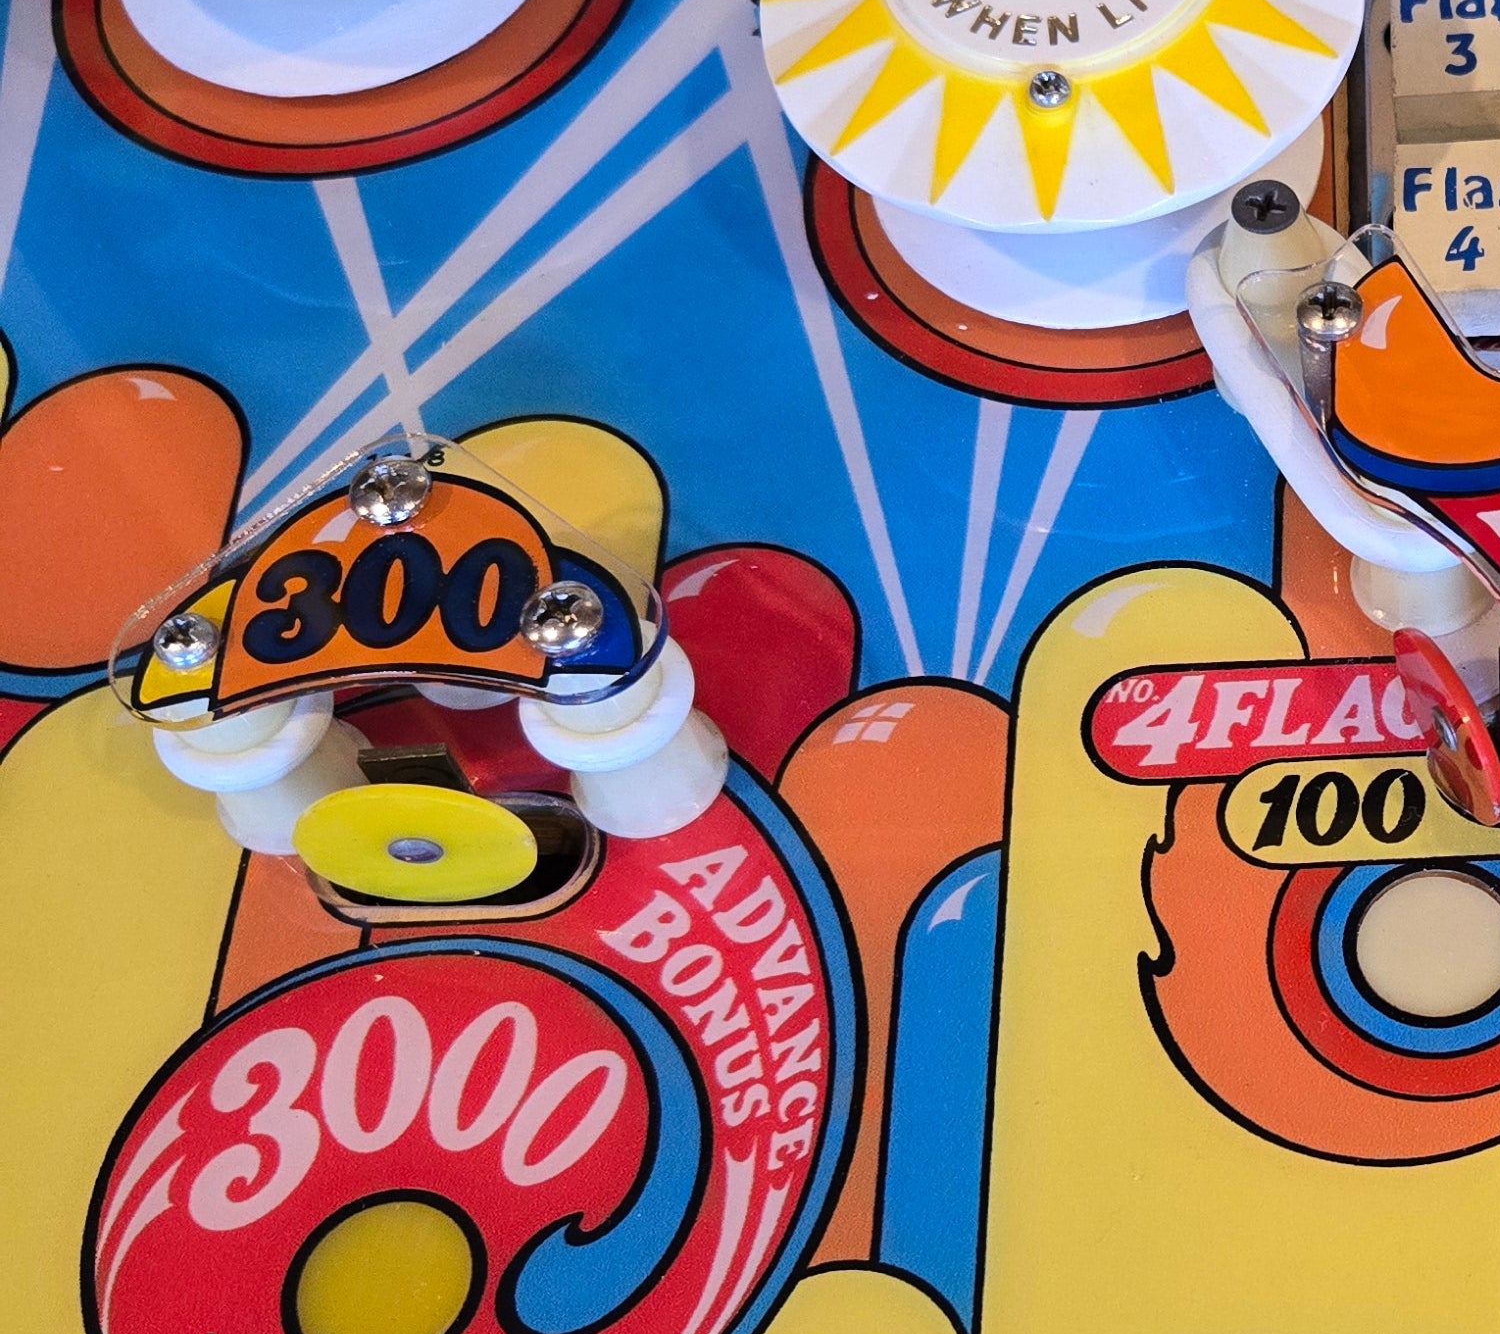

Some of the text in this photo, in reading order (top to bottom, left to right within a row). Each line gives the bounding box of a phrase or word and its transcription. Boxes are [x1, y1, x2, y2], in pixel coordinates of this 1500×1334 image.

[1444, 31, 1478, 77] 3
[1444, 225, 1485, 272] 4
[242, 531, 540, 664] 300
[1104, 677, 1160, 705] NO.
[1112, 674, 1206, 767] 4
[1252, 768, 1427, 852] 100
[600, 889, 770, 1128] BONUS
[659, 843, 828, 1172] ADVANCE
[187, 995, 629, 1232] 3000
